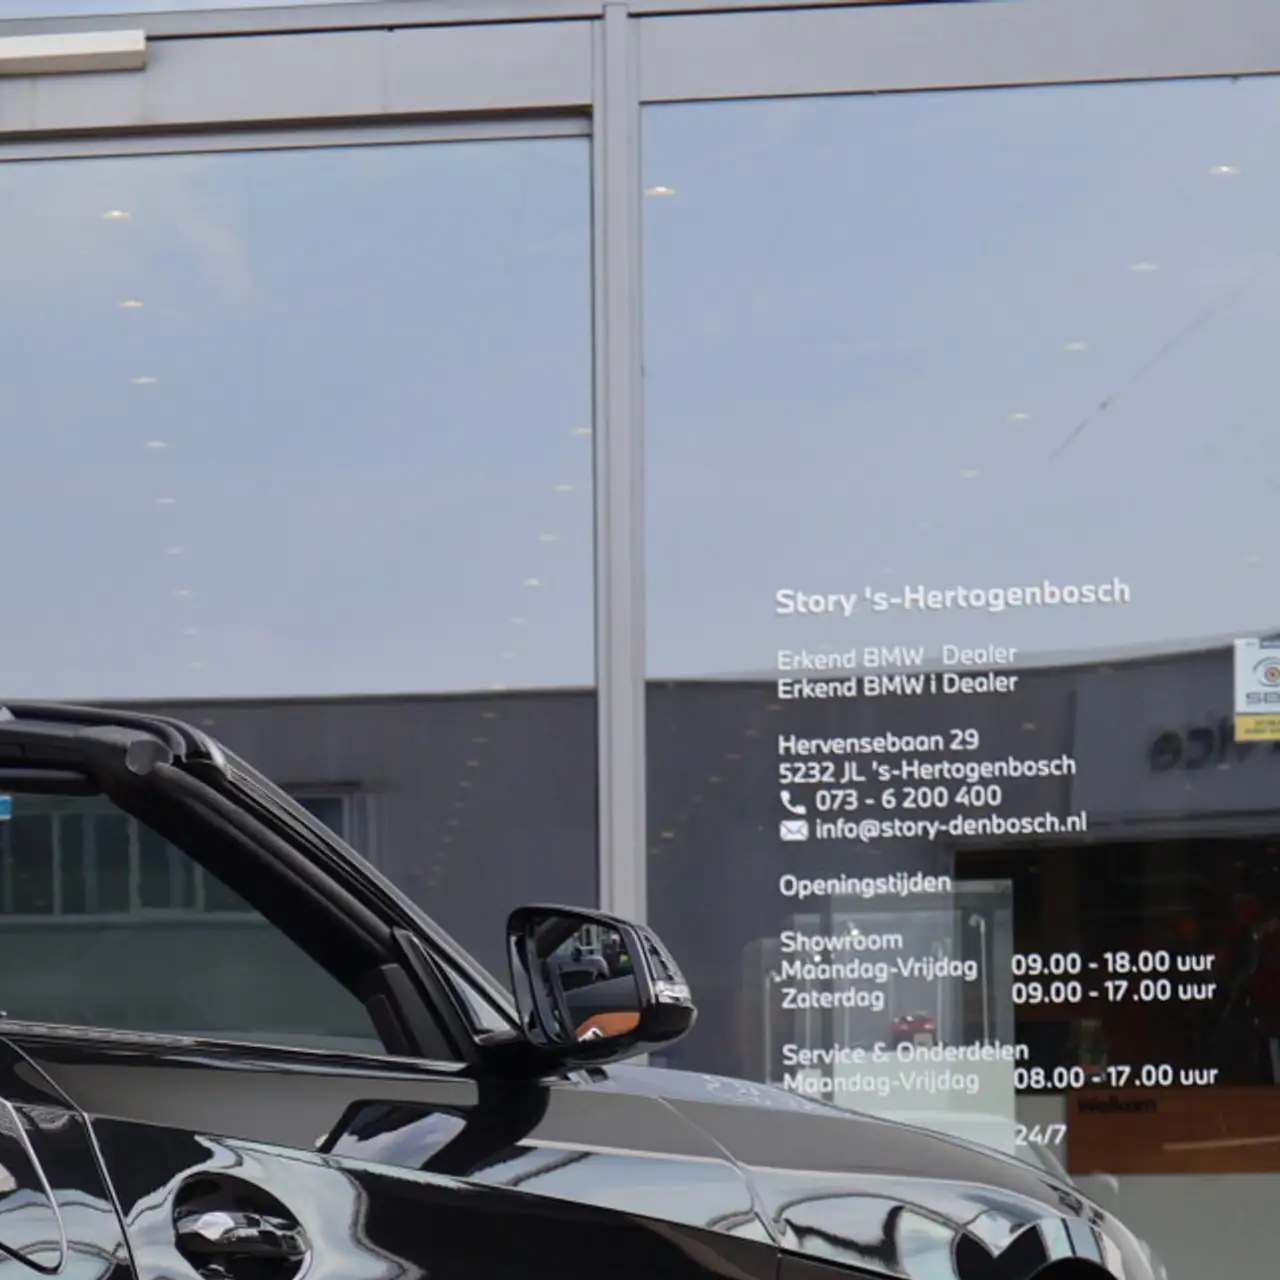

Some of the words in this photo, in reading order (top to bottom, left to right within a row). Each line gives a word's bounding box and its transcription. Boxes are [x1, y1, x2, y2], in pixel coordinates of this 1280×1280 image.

[775, 589, 857, 617] Story
[864, 578, 1130, 613] 's-Hertogenbosch
[778, 649, 856, 671] Erkend
[864, 648, 924, 668] BMW
[943, 645, 1017, 665] Dealer
[778, 678, 856, 699] Erkend
[864, 676, 926, 696] BMW
[930, 675, 937, 695] i
[943, 673, 1018, 694] Dealer
[779, 732, 944, 756] Hervensebaan
[950, 729, 979, 751] 29
[779, 762, 835, 784] 5232
[840, 761, 865, 782] JL
[872, 755, 1076, 786] 's-Hertogenbosch
[816, 789, 858, 811] 073
[881, 788, 896, 809] 6
[902, 787, 949, 809] 200
[955, 785, 1002, 807] 400
[816, 811, 1088, 843] info@story-denbosch.nl
[779, 872, 952, 898] Openingstijden
[780, 932, 903, 952] Showroom
[781, 956, 978, 981] Maandag-Vrijdag
[1011, 953, 1081, 975] 09.00
[1104, 951, 1170, 972] 18.00
[1176, 955, 1216, 972] uur
[781, 988, 885, 1010] Zaterdag
[1011, 982, 1082, 1003] 09.00
[1177, 984, 1217, 1000] uur
[782, 1044, 864, 1066] Service
[873, 1043, 889, 1062] &
[897, 1040, 1029, 1063] Onderdelen
[783, 1070, 980, 1096] Maandag-Vrijdag
[1014, 1066, 1085, 1089] 08.00
[1180, 1068, 1218, 1085] uur
[1013, 1123, 1067, 1146] 24/7
